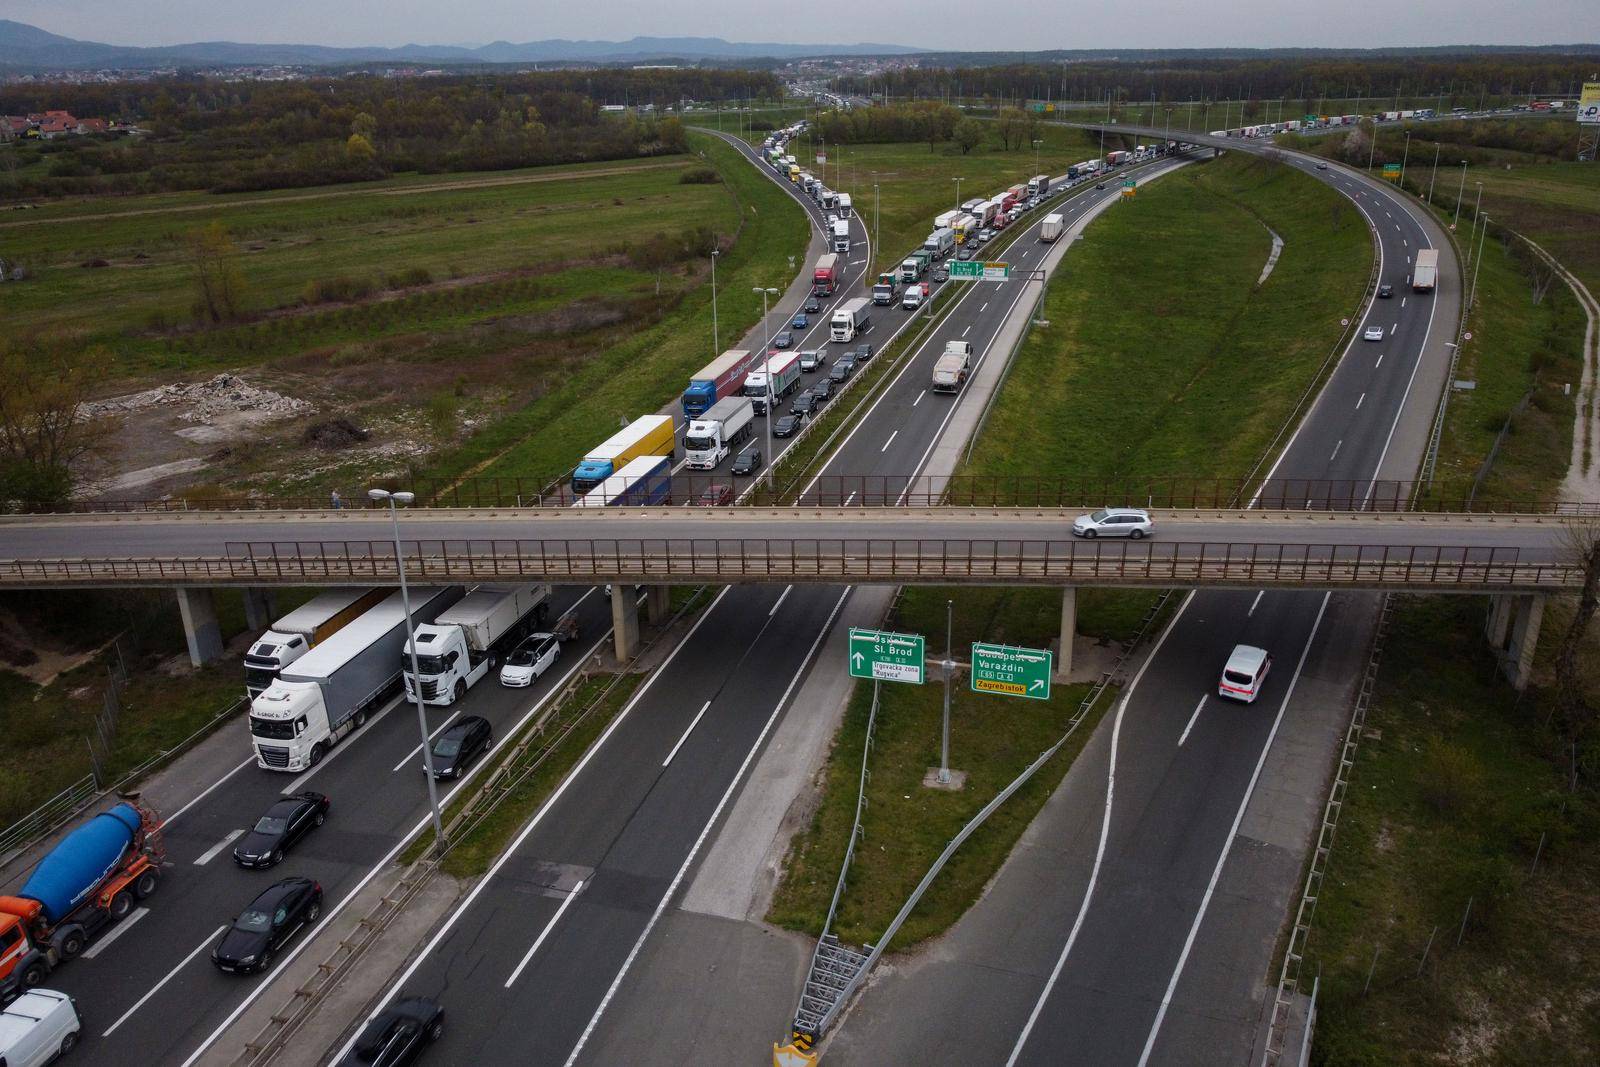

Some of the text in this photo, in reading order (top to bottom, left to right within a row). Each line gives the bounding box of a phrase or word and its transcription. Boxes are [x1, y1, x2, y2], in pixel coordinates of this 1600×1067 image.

[874, 645, 912, 656] Sl. Brod
[978, 660, 1024, 672] Varaždin
[977, 680, 1004, 690] Zagreb
